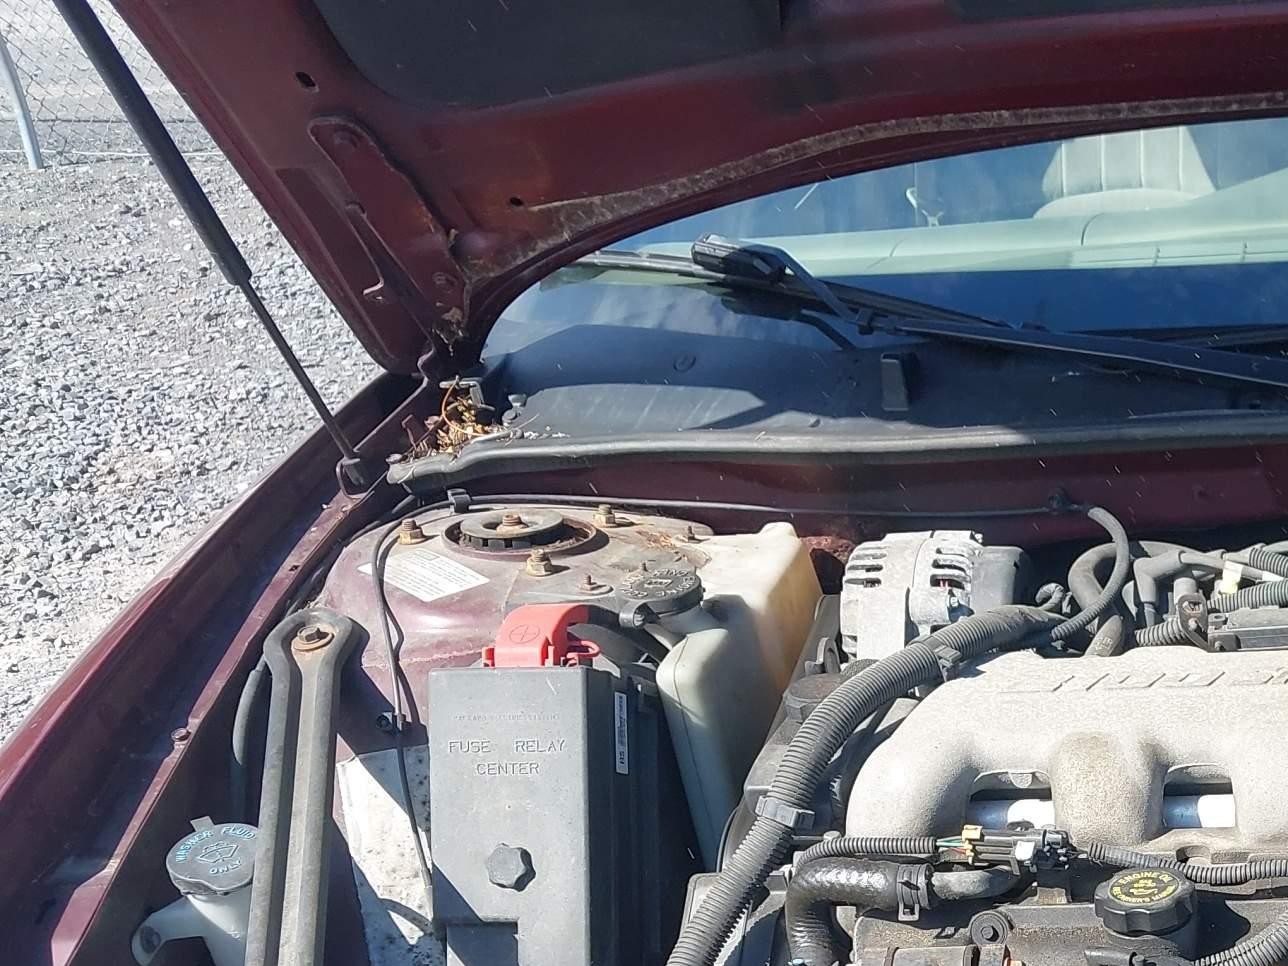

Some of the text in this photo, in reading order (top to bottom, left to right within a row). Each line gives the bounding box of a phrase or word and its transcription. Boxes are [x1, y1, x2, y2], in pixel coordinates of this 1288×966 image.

[448, 740, 566, 753] FUSE RELAY
[476, 762, 540, 776] CENTER
[175, 826, 257, 864] WASHER FLUID
[208, 859, 242, 875] ONLY
[1118, 872, 1174, 884] ENGINE OIL
